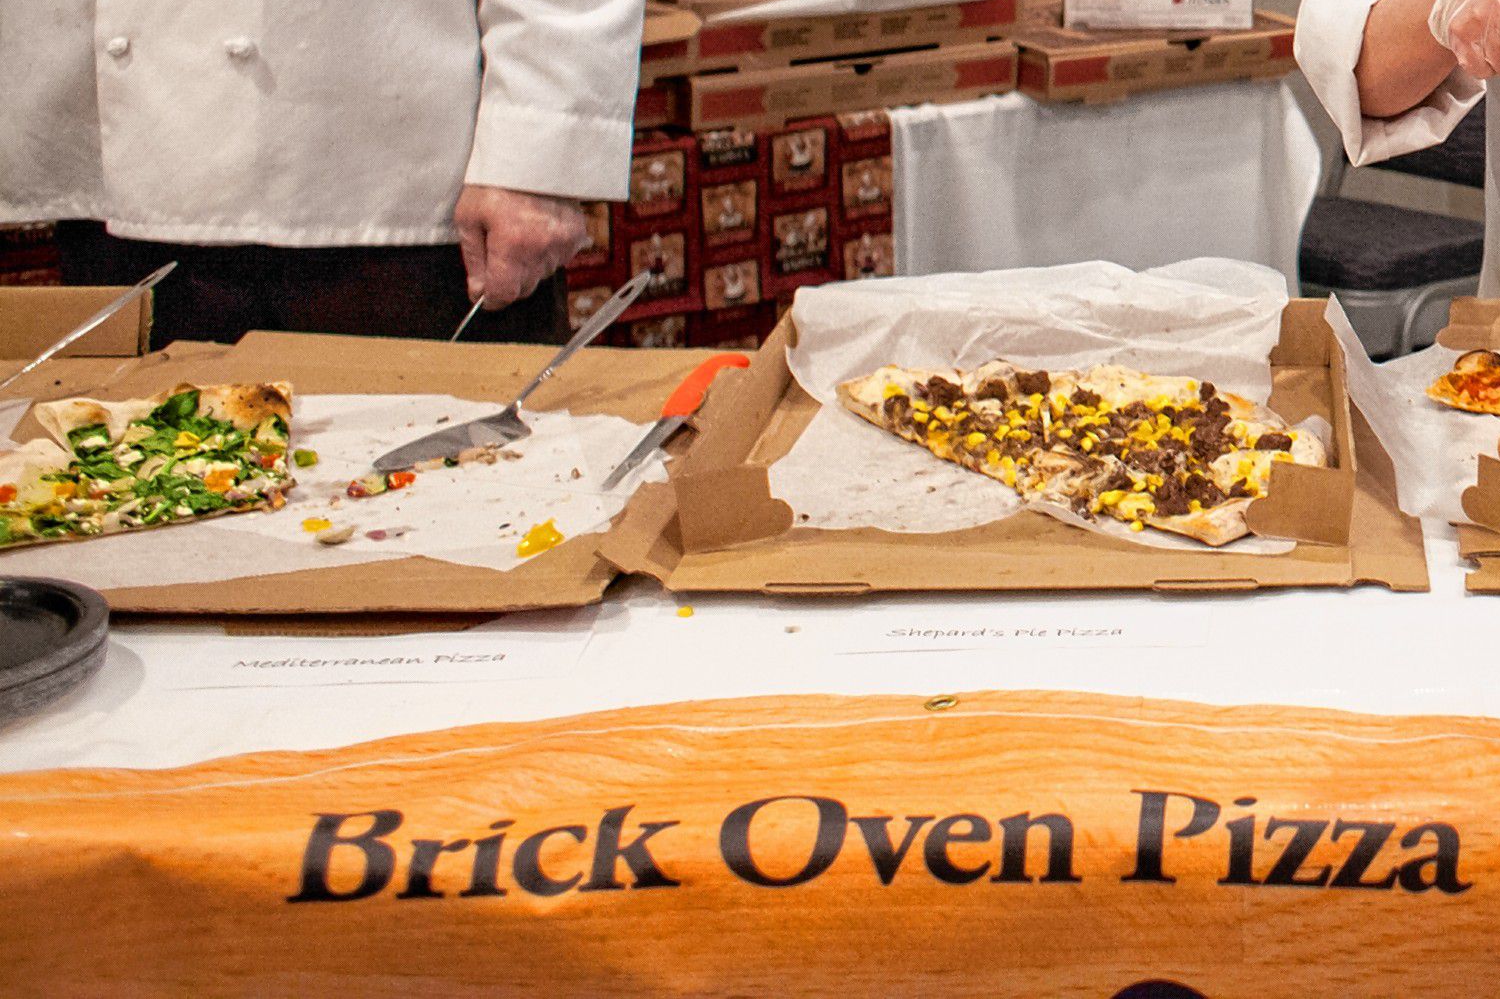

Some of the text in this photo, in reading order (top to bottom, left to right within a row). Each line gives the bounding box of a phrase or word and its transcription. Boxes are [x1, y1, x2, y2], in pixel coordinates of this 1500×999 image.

[886, 627, 1123, 640] Shepard's Pie Pizza
[232, 651, 517, 669] Mediterranean Pizza
[286, 789, 1474, 900] Brick Oven Pizza
